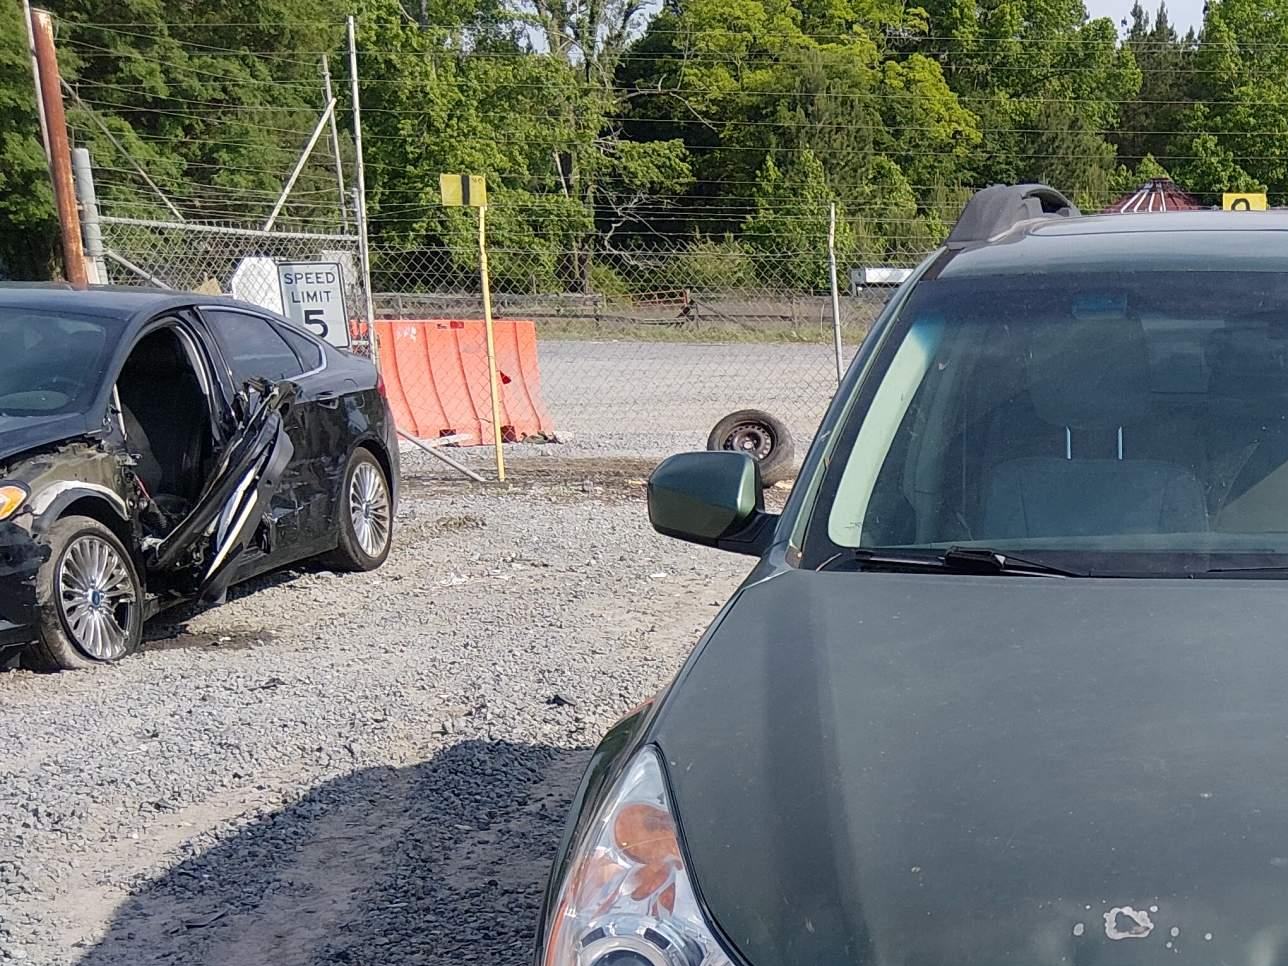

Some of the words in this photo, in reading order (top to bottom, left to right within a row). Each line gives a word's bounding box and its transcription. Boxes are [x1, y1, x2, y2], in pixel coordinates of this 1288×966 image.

[284, 271, 335, 285] SPEED
[291, 290, 331, 303] LIMIT
[303, 309, 329, 339] 5
